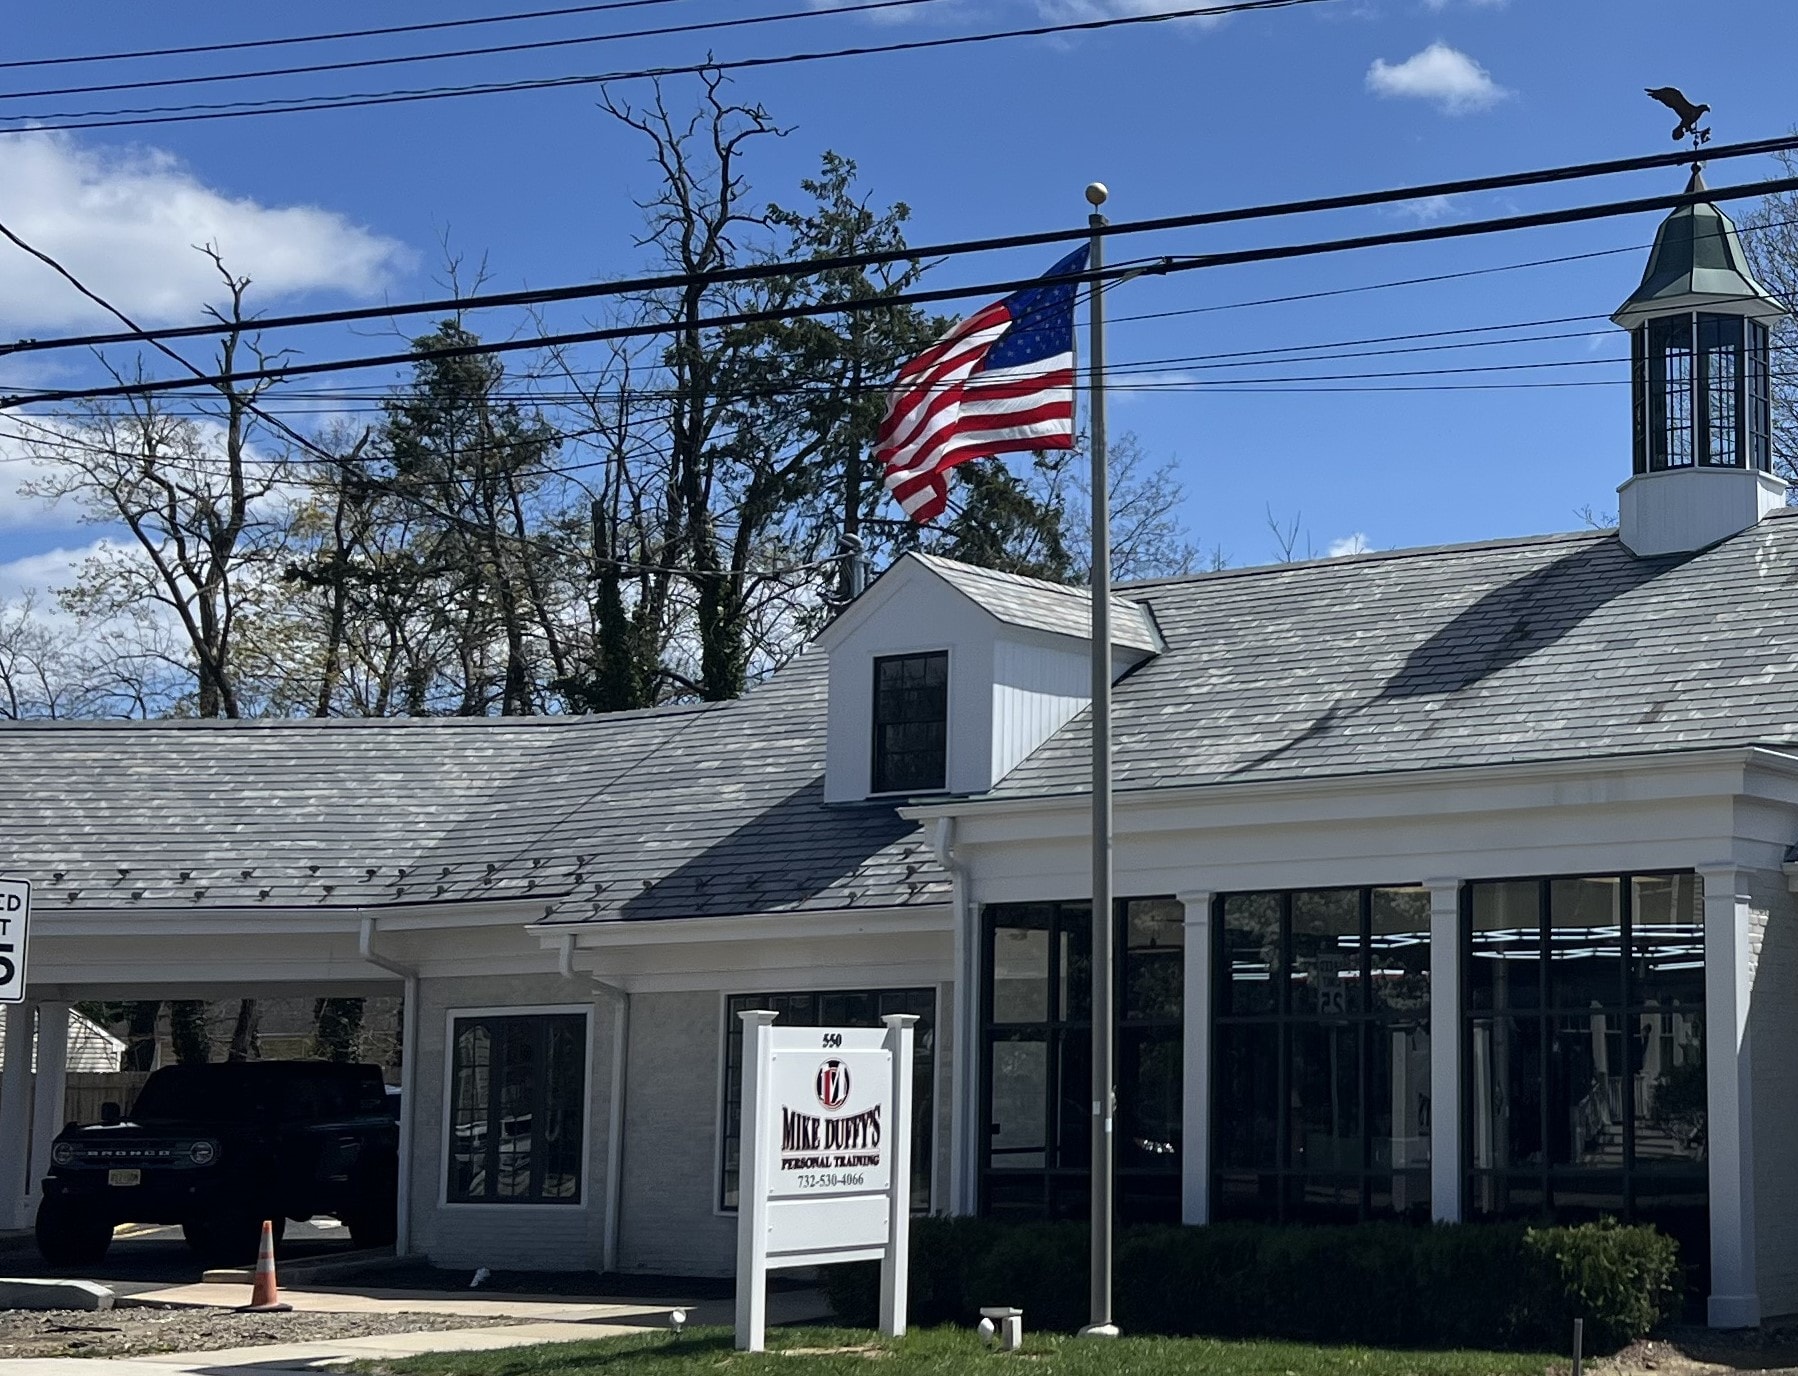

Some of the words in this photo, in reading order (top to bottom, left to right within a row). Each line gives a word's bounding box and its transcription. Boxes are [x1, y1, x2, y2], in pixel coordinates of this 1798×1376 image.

[822, 1033, 842, 1048] 550
[781, 1105, 821, 1151] MIKE
[823, 1103, 881, 1150] DUFFY'S
[781, 1156, 832, 1170] PERSONAL
[834, 1154, 880, 1168] TRAINING
[797, 1173, 864, 1188] 732-530-4066
